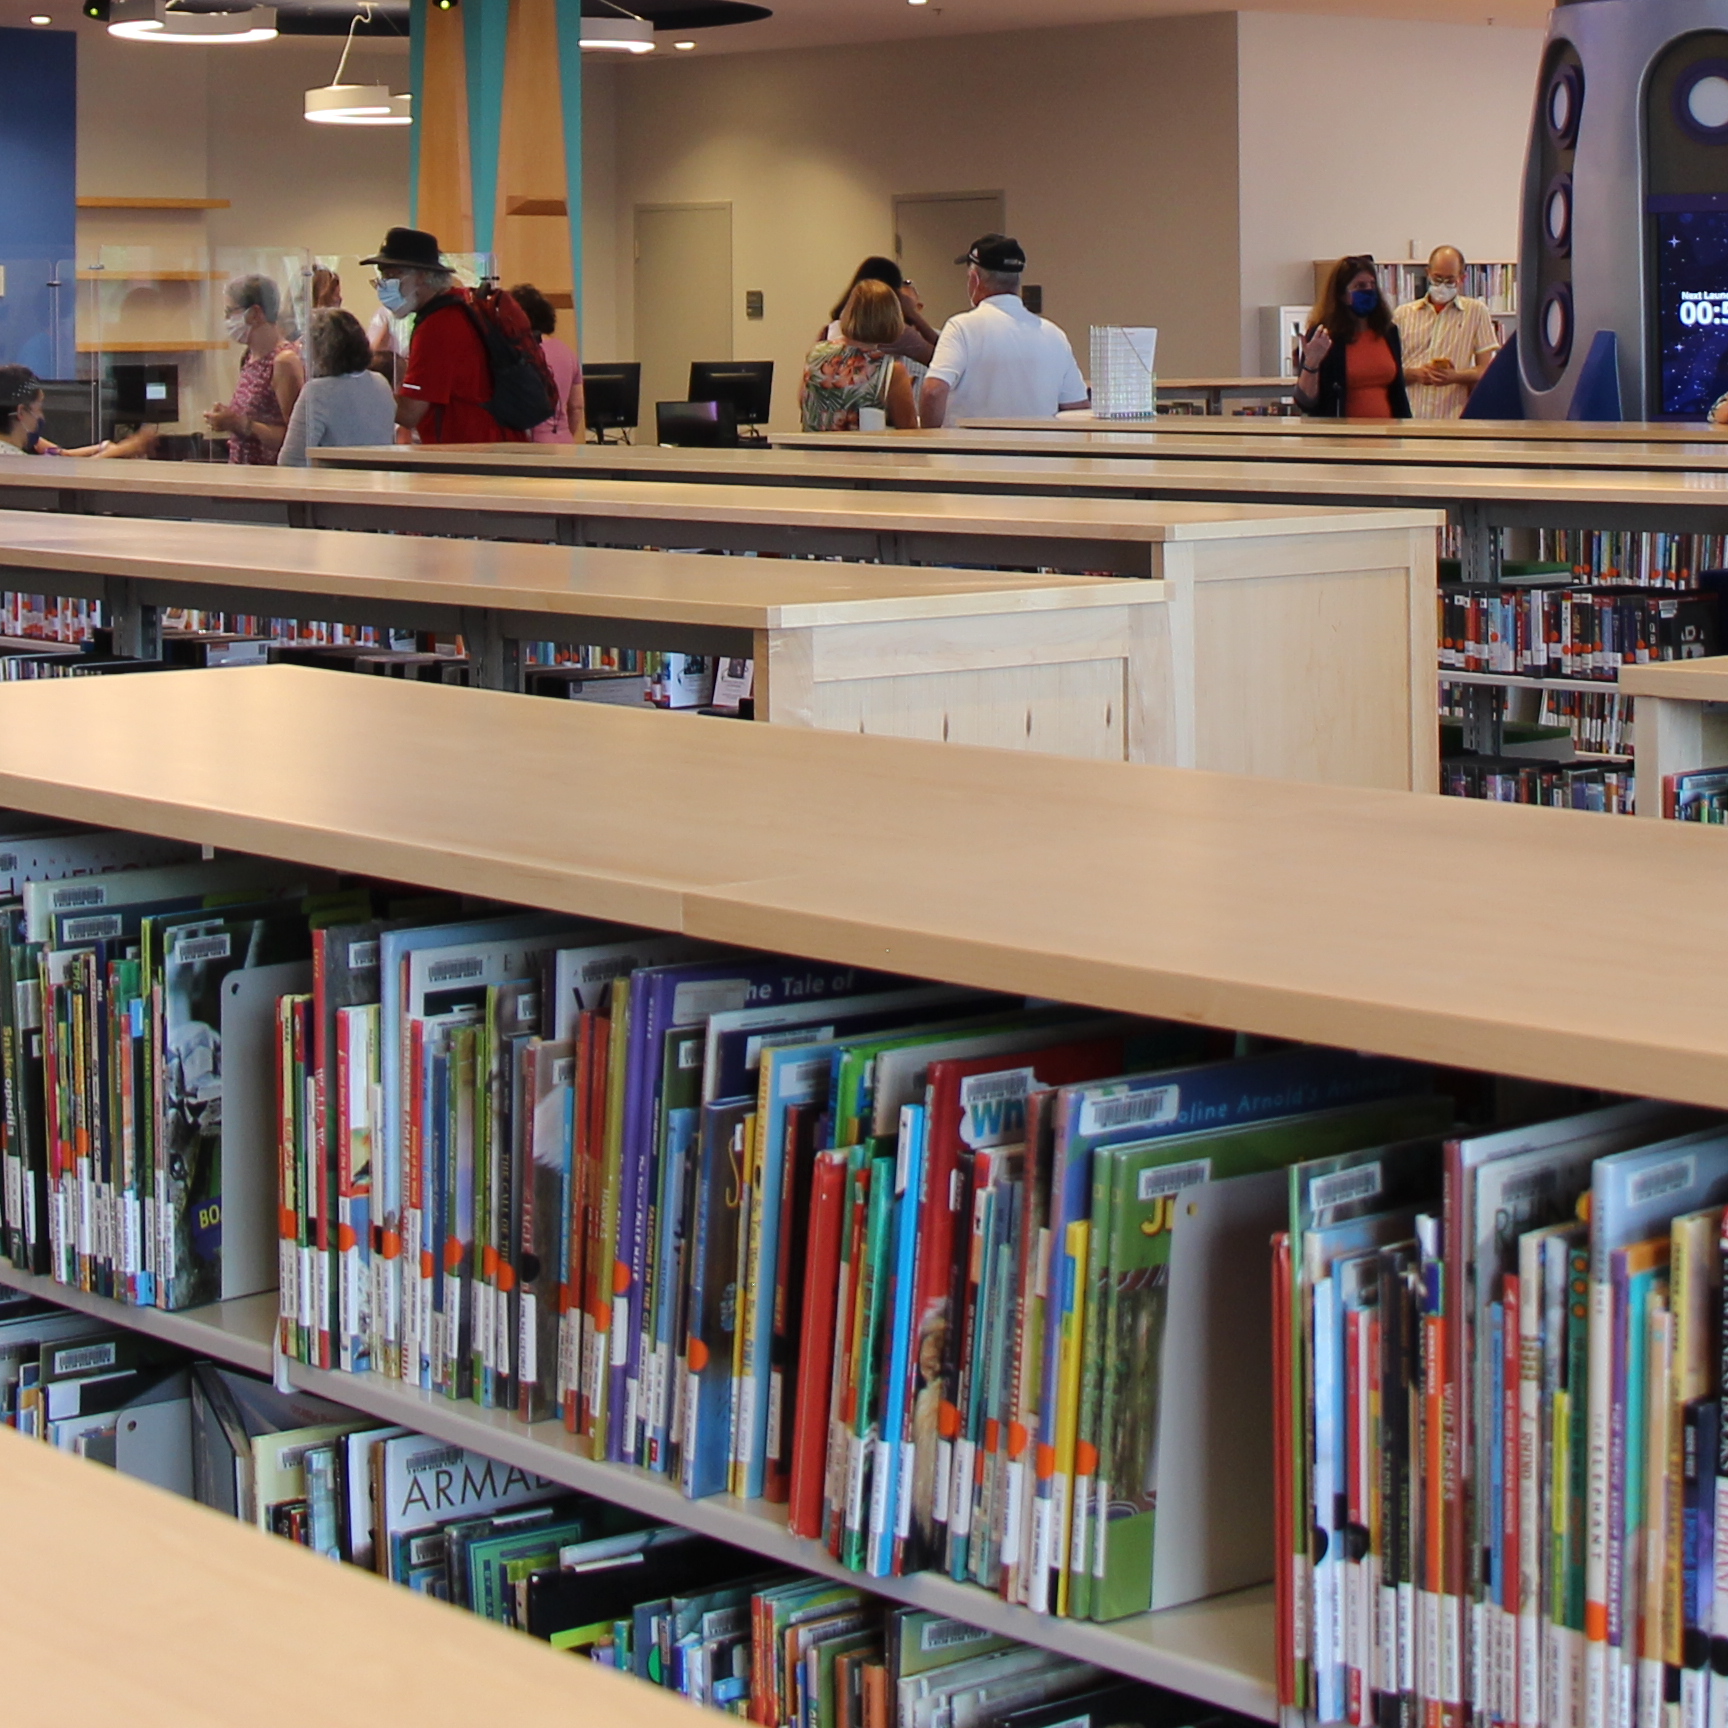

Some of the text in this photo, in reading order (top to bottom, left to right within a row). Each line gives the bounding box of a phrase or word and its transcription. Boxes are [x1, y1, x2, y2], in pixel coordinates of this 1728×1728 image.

[1681, 291, 1703, 300] Next
[746, 968, 856, 1001] he Tale of
[3, 1025, 19, 1137] Snakeopedia
[1237, 1088, 1320, 1117] Arnold's
[638, 1154, 646, 1173] The
[502, 1153, 510, 1234] THE CALL OF
[637, 1176, 645, 1195] Tale
[599, 1188, 610, 1240] HAWKS
[634, 1210, 643, 1243] PALE
[632, 1246, 641, 1281] MALE
[642, 1204, 655, 1336] FALCONS IN THE CIT
[1442, 1382, 1457, 1502] WILD HORSES
[1590, 1443, 1608, 1560] ELEPHANT
